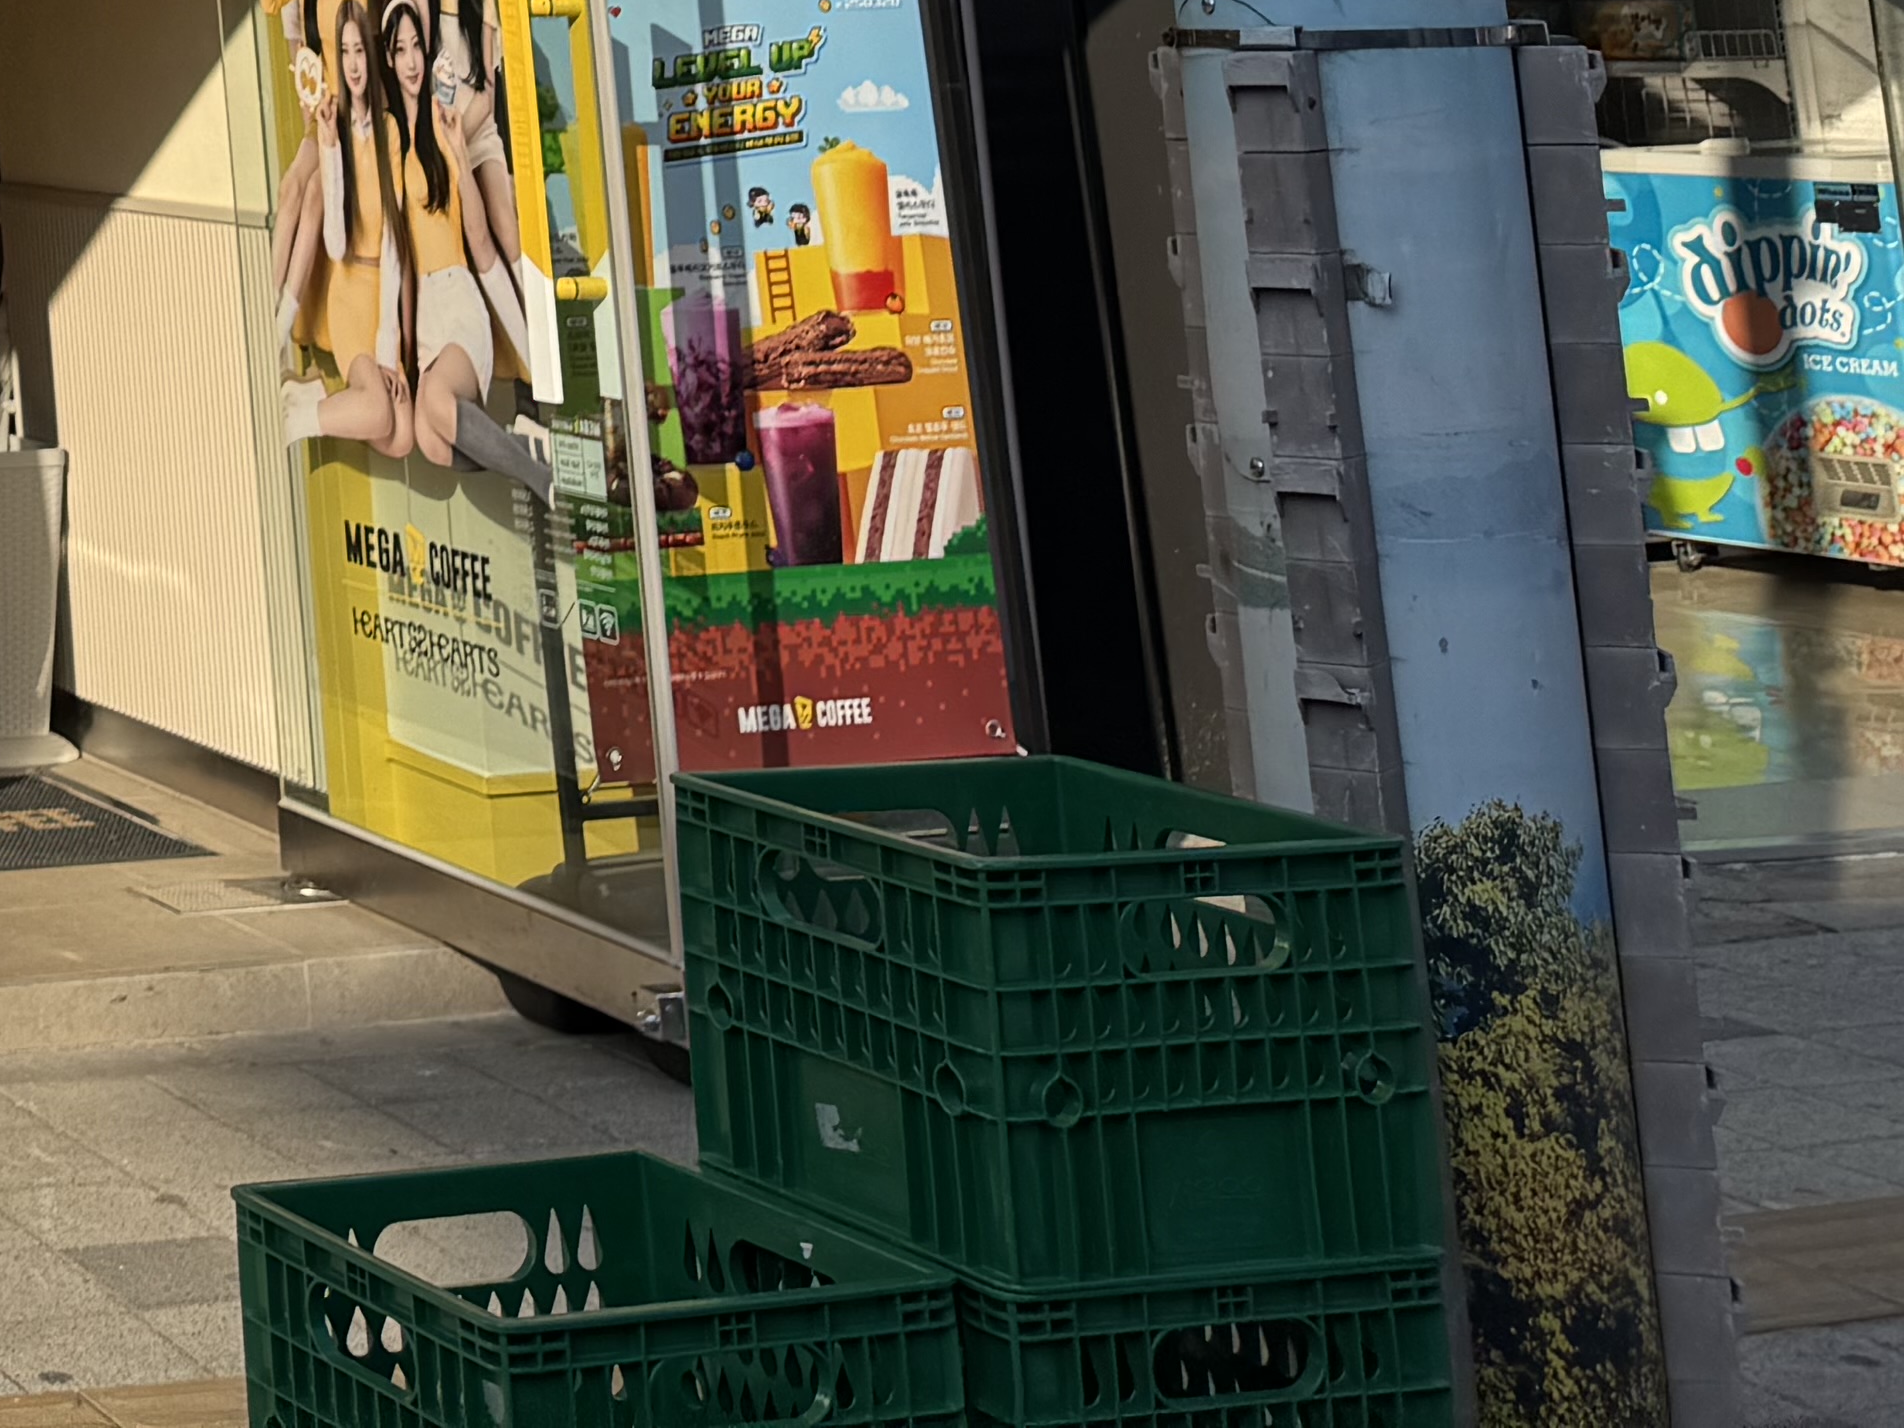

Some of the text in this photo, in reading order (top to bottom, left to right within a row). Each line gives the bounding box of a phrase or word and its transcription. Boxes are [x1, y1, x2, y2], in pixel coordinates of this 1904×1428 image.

[704, 24, 761, 45] MEGA
[652, 38, 819, 89] LEVEL UP
[702, 78, 763, 105] YOUR
[667, 97, 803, 143] ENERGY
[1778, 288, 1845, 332] dots
[1803, 352, 1900, 378] ICE CREAM
[343, 519, 493, 602] MEGA COFFEE
[738, 695, 874, 736] MEGA COFFEE
